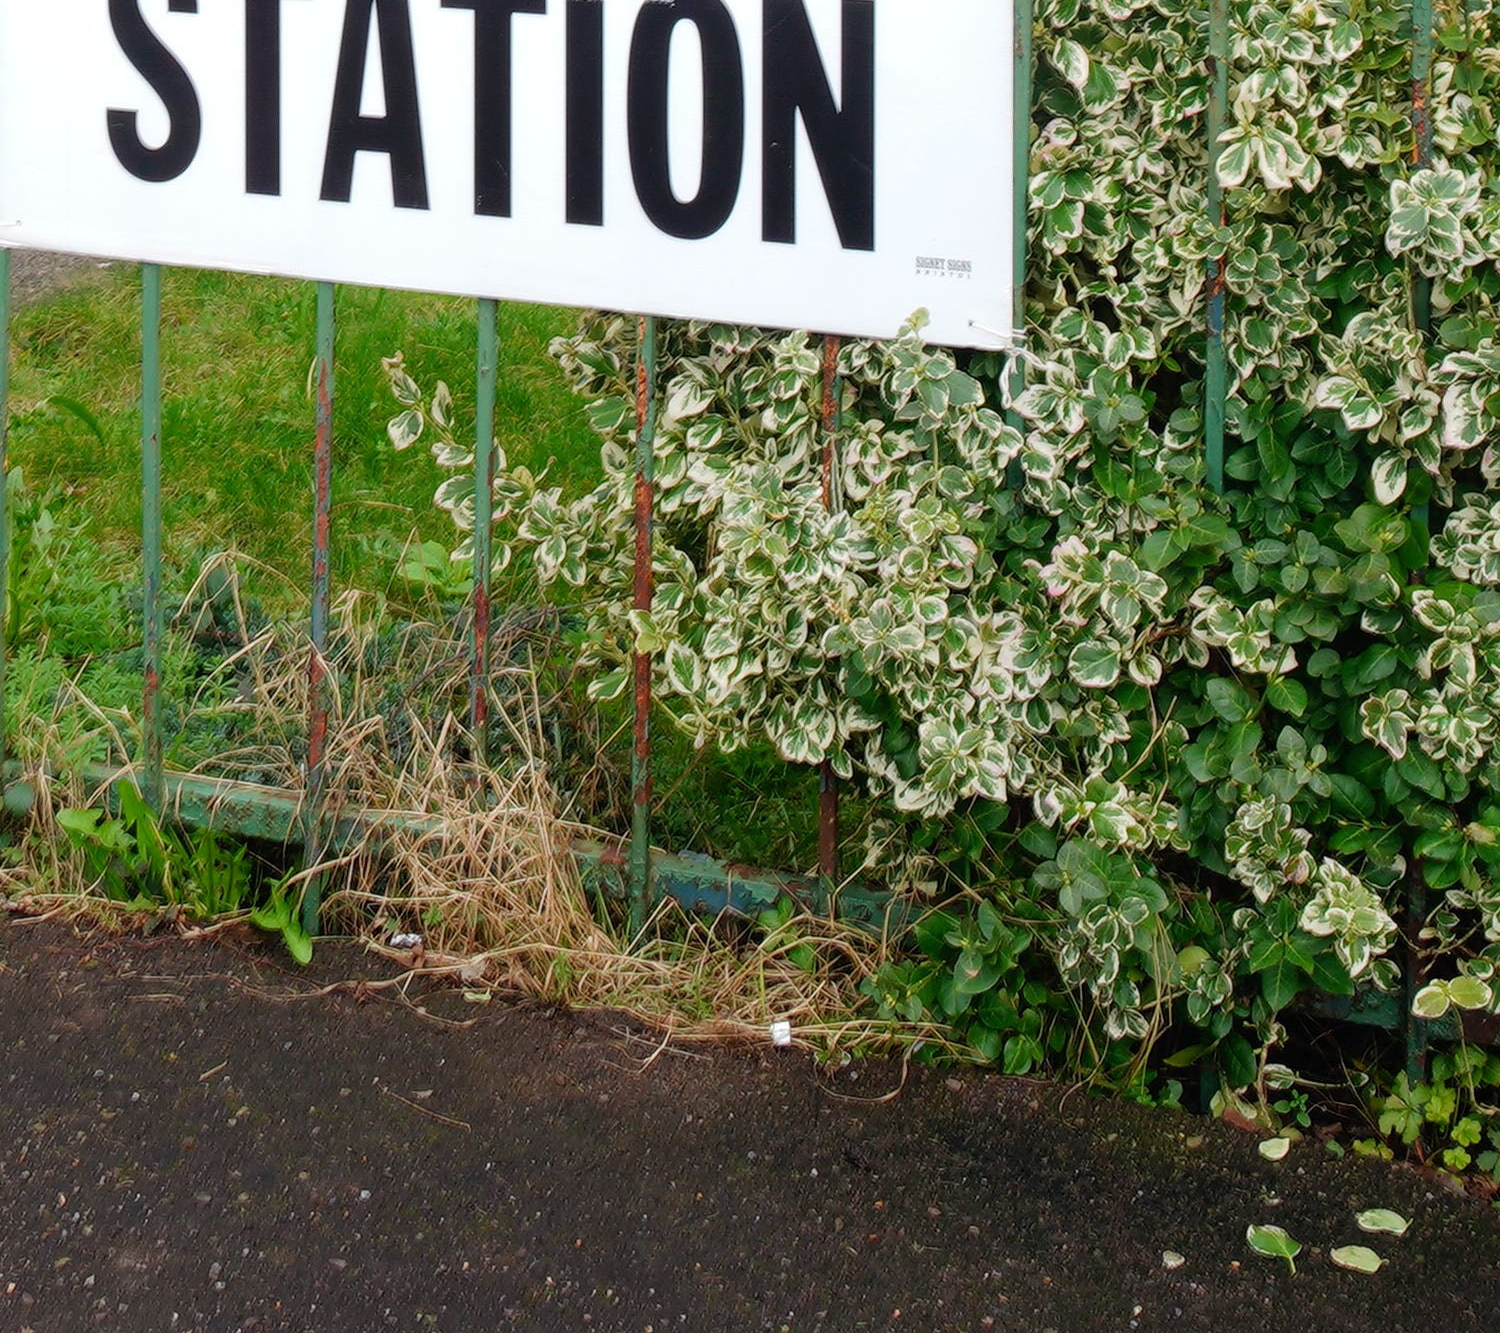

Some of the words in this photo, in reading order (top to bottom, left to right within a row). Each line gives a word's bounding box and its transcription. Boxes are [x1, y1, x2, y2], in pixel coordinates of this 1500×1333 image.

[915, 256, 945, 270] SIGNET
[947, 258, 973, 273] SIGNS
[916, 269, 971, 279] BRISTOL
